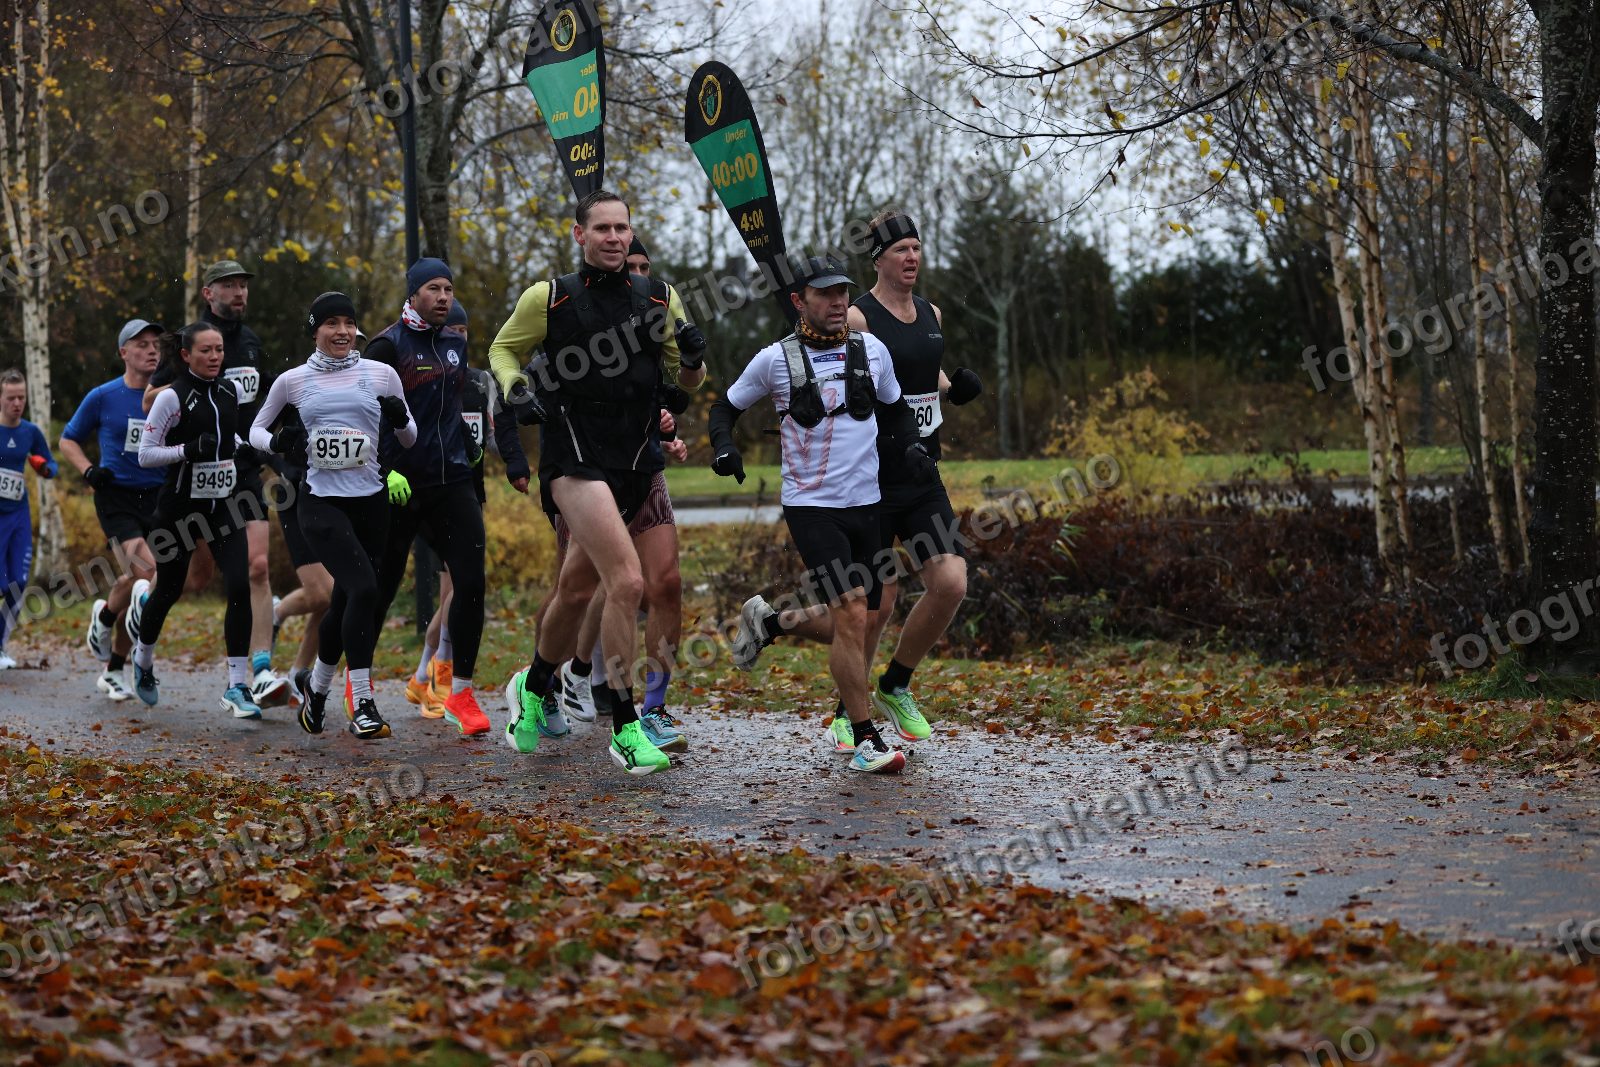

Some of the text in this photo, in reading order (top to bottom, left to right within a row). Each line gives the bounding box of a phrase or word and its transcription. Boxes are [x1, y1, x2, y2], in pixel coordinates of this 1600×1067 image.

[725, 128, 747, 143] Under
[712, 152, 758, 189] 40:00
[740, 208, 764, 232] 4:00
[234, 376, 256, 393] 02
[316, 437, 365, 459] 9517
[196, 470, 233, 489] 9495
